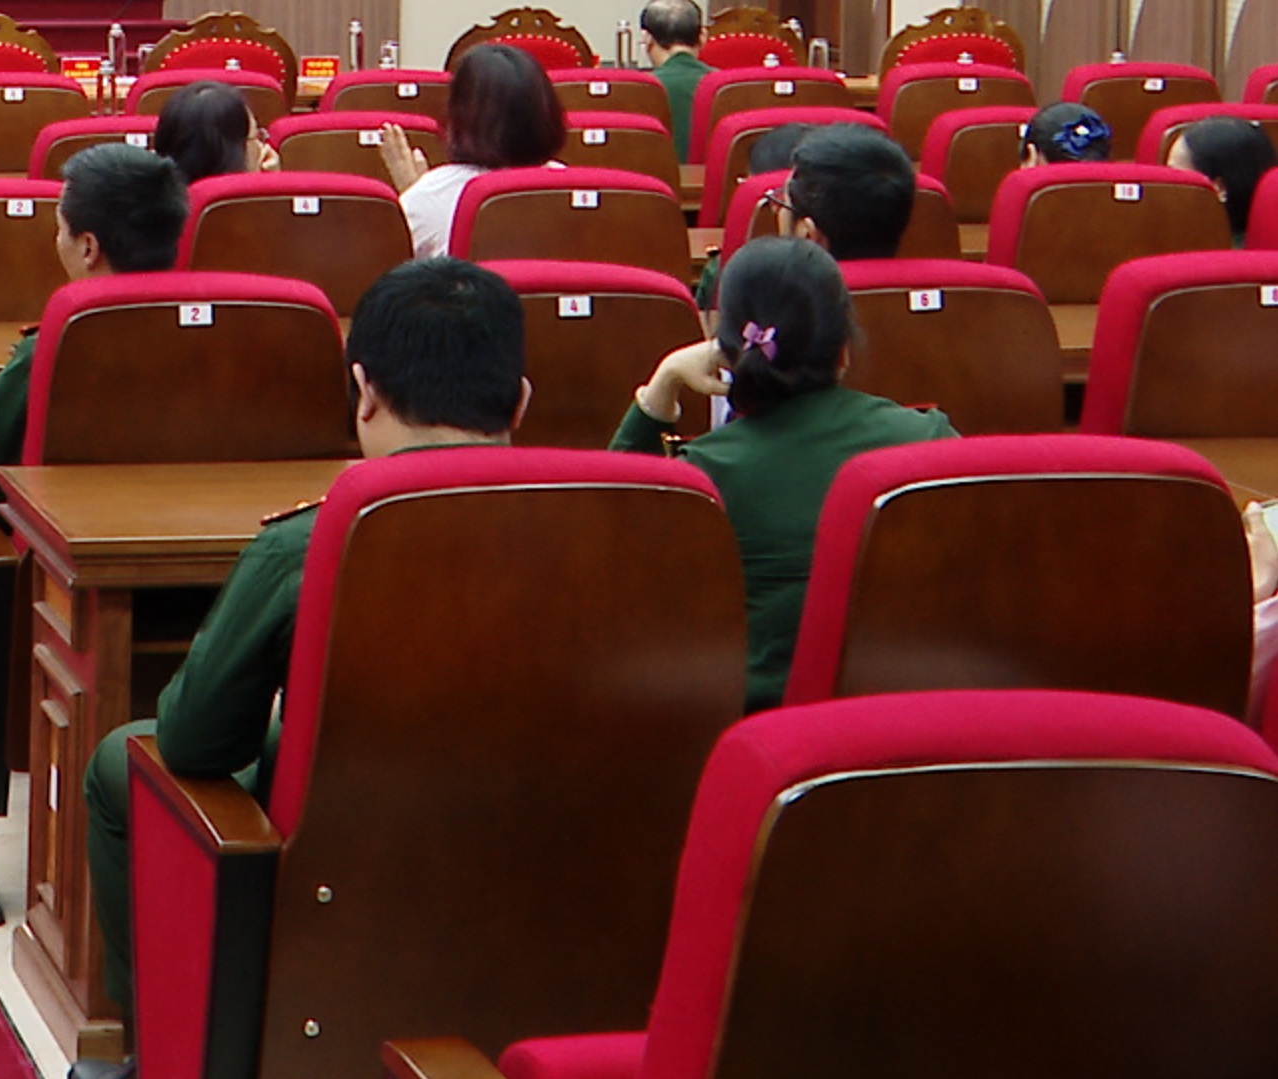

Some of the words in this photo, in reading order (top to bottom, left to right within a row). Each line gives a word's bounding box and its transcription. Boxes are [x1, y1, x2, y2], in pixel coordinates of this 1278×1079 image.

[16, 202, 24, 213] 2
[569, 299, 579, 312] 4
[920, 293, 929, 306] 6
[191, 307, 200, 321] 2
